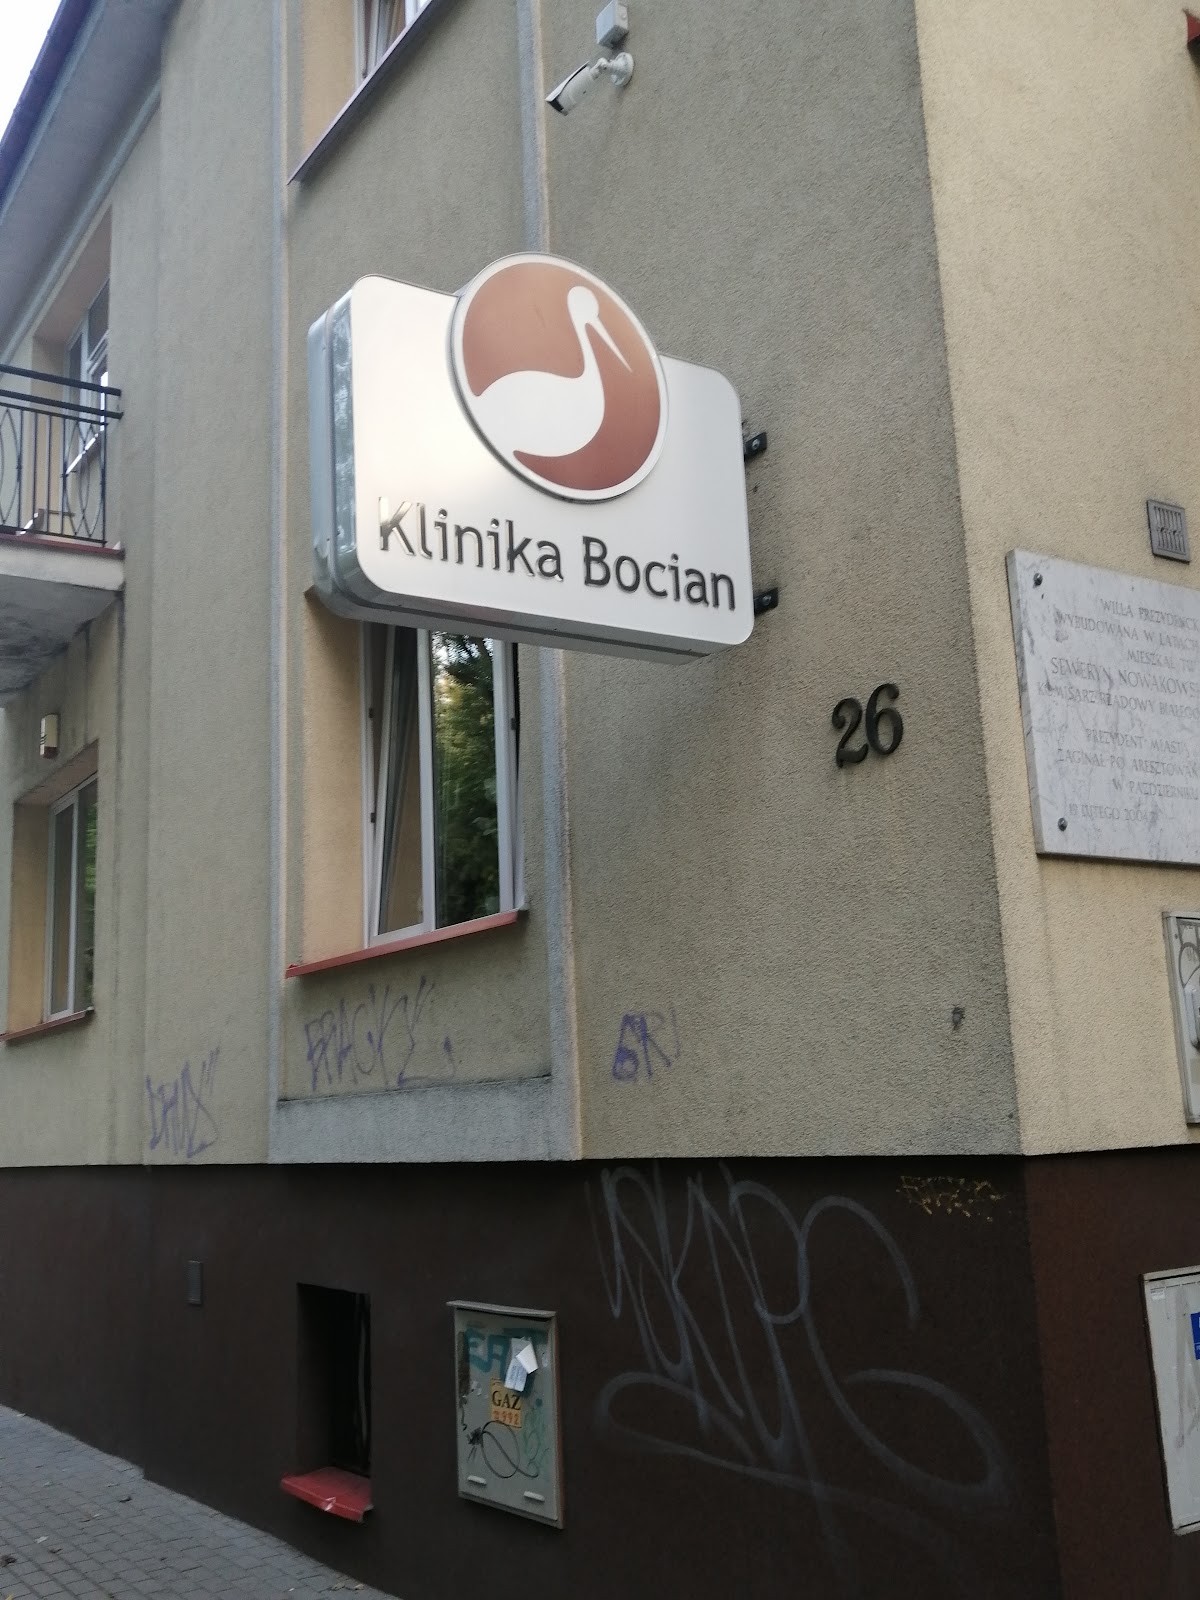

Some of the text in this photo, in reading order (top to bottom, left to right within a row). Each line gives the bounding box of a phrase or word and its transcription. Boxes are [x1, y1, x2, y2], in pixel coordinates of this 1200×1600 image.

[378, 496, 736, 611] Klinika Bocian
[1099, 598, 1134, 618] WILLA
[1143, 629, 1154, 642] W
[1050, 656, 1115, 688] SEWERYN
[832, 684, 904, 768] 26
[1085, 727, 1145, 750] PREZYDENT
[1080, 804, 1121, 820] LUTEGO
[491, 1389, 522, 1411] GAZ
